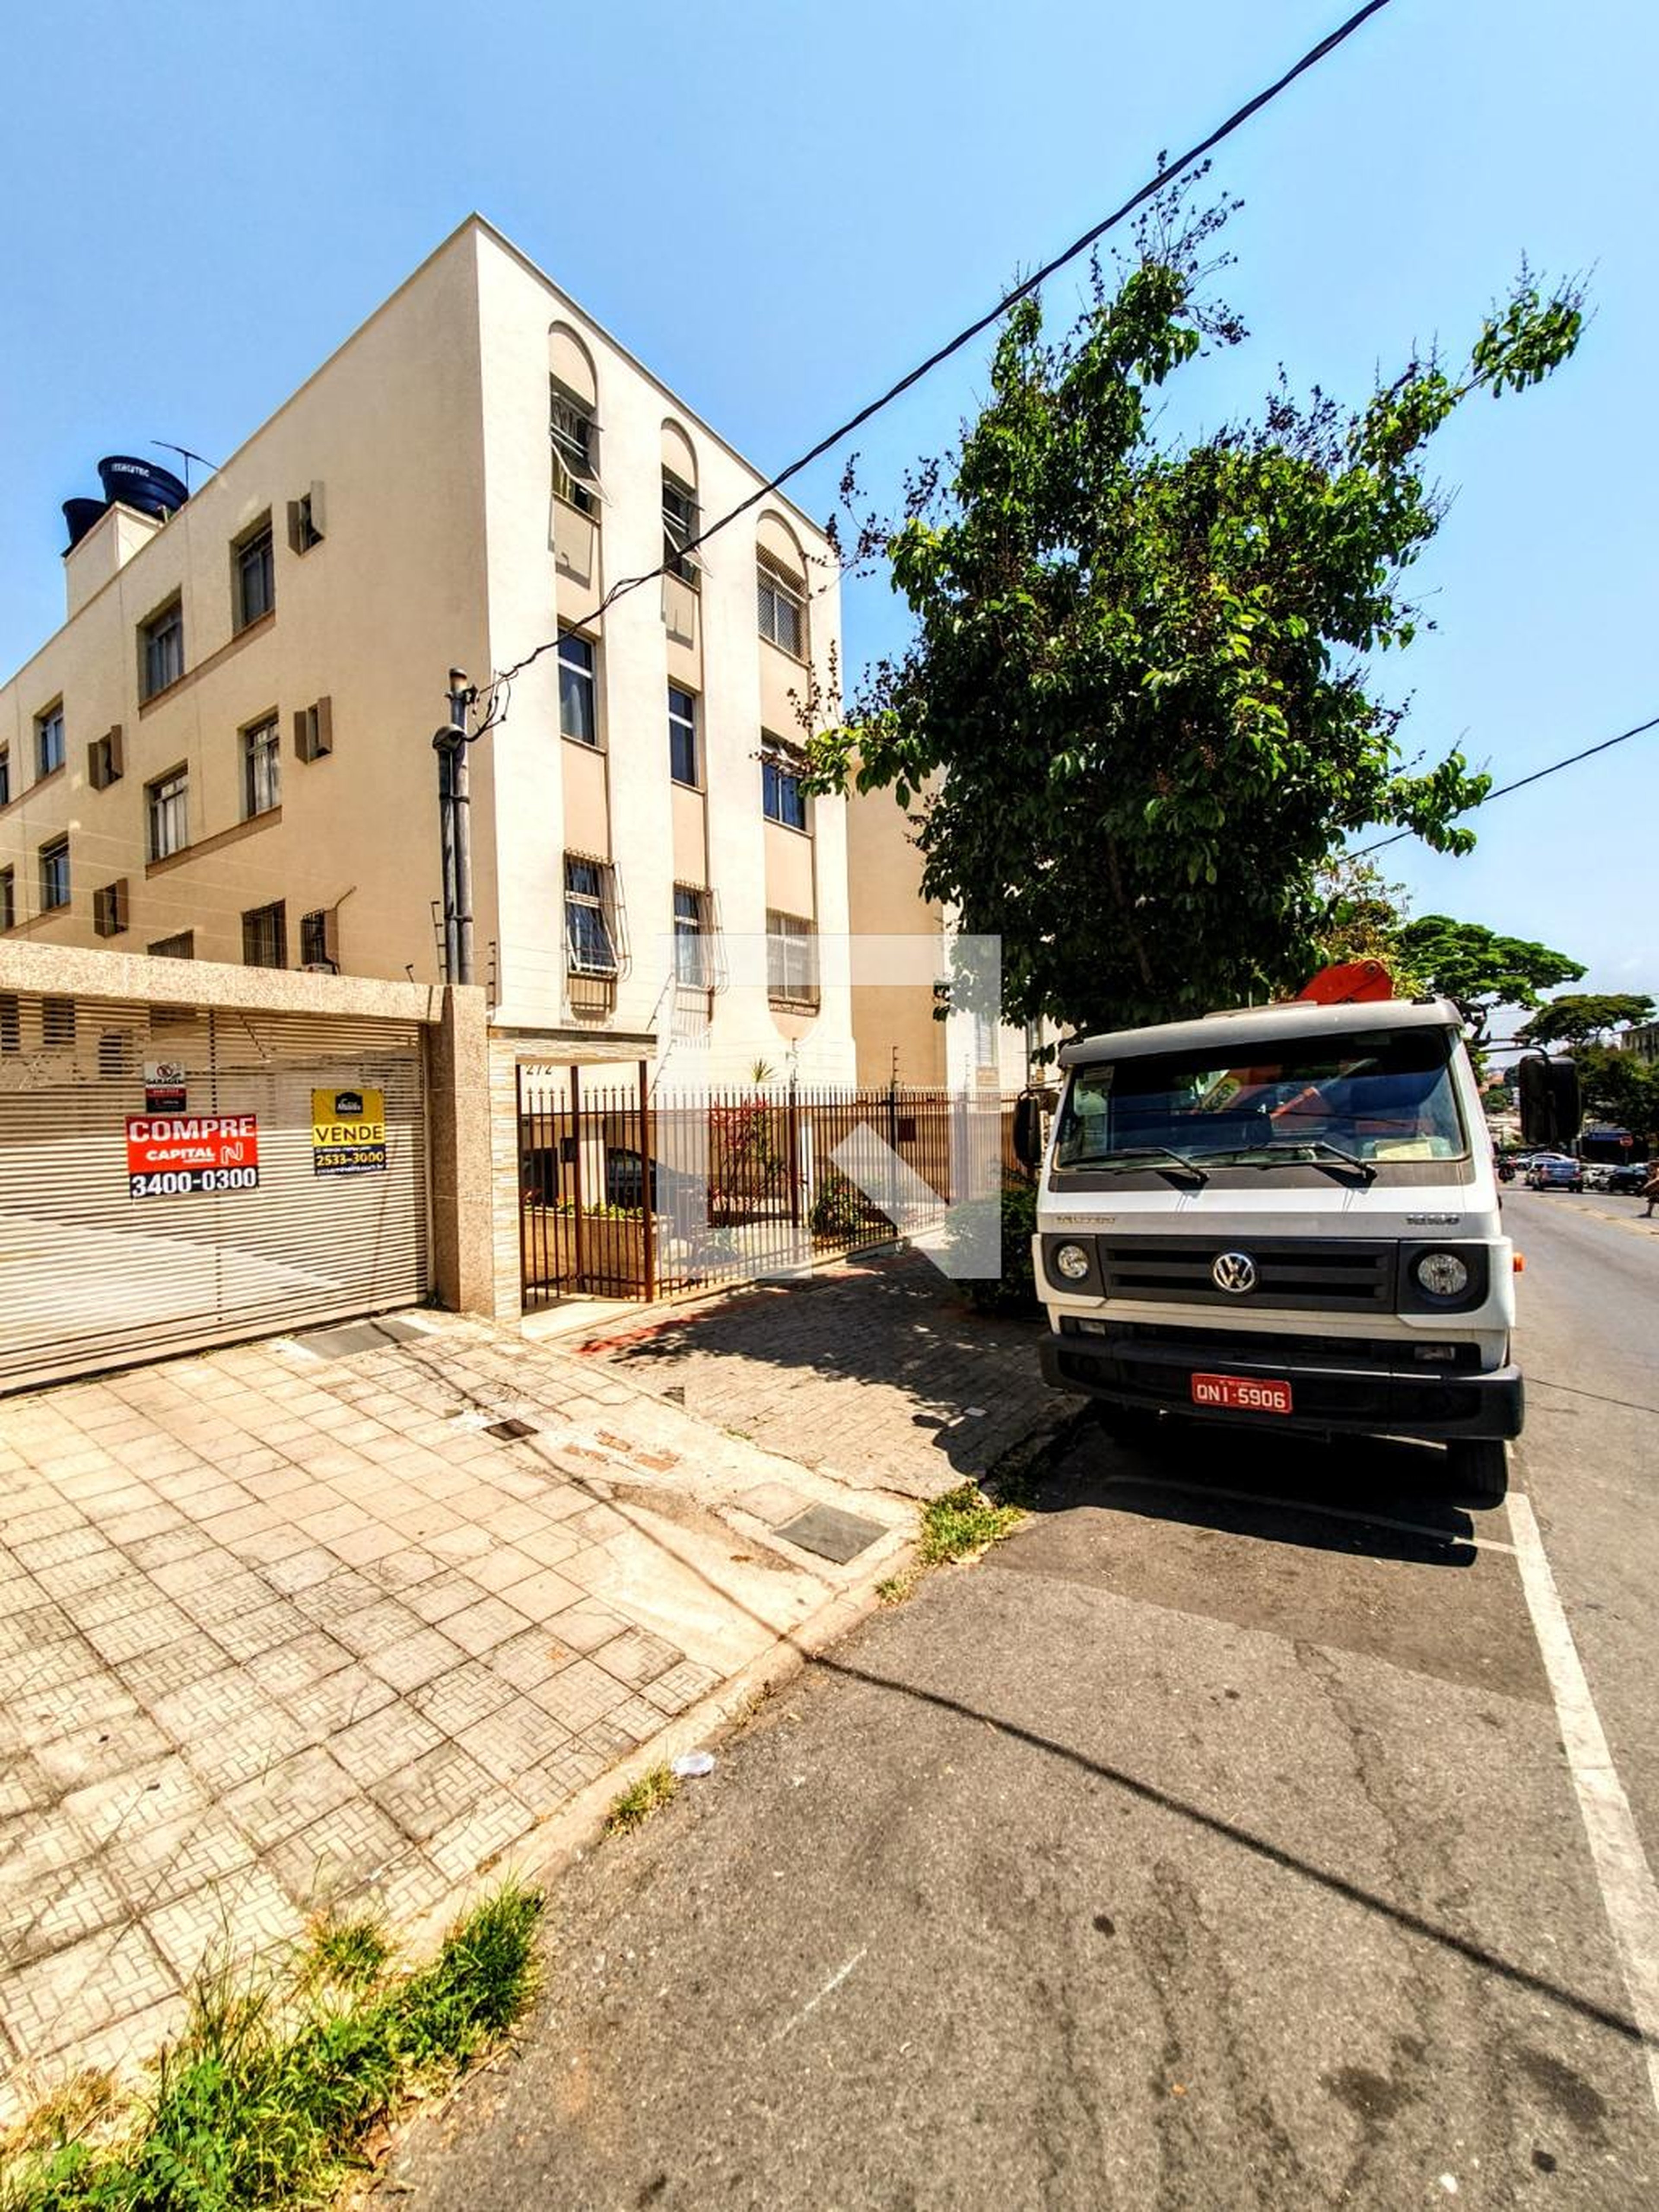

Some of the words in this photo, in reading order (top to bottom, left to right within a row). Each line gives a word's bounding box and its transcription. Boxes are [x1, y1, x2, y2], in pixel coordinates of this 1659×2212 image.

[129, 1117, 254, 1143] COMPRE
[315, 1126, 382, 1142] VENDE
[146, 1147, 215, 1160] CAPITAL
[316, 1151, 384, 1166] 2533-3000
[131, 1167, 256, 1197] 3400-0300
